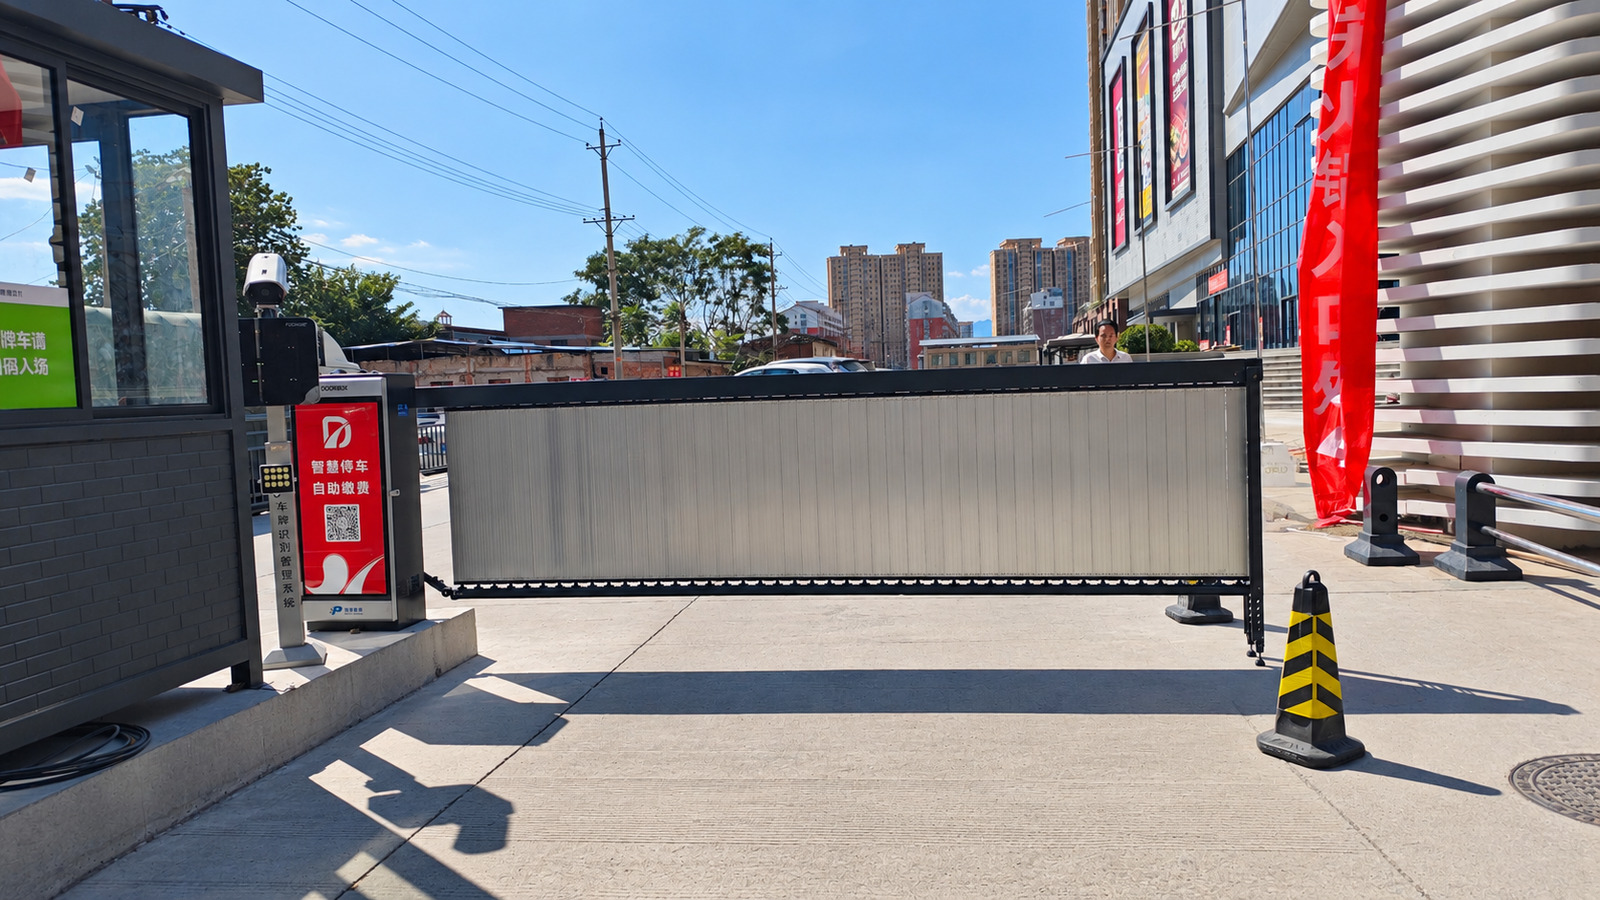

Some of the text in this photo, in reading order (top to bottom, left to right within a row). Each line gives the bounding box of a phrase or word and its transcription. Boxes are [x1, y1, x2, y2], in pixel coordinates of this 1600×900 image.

[0, 357, 49, 375] 码入场
[311, 459, 369, 475] 智慧停车
[312, 481, 370, 496] 自助缴费
[276, 501, 295, 609] 车牌识别管理系统
